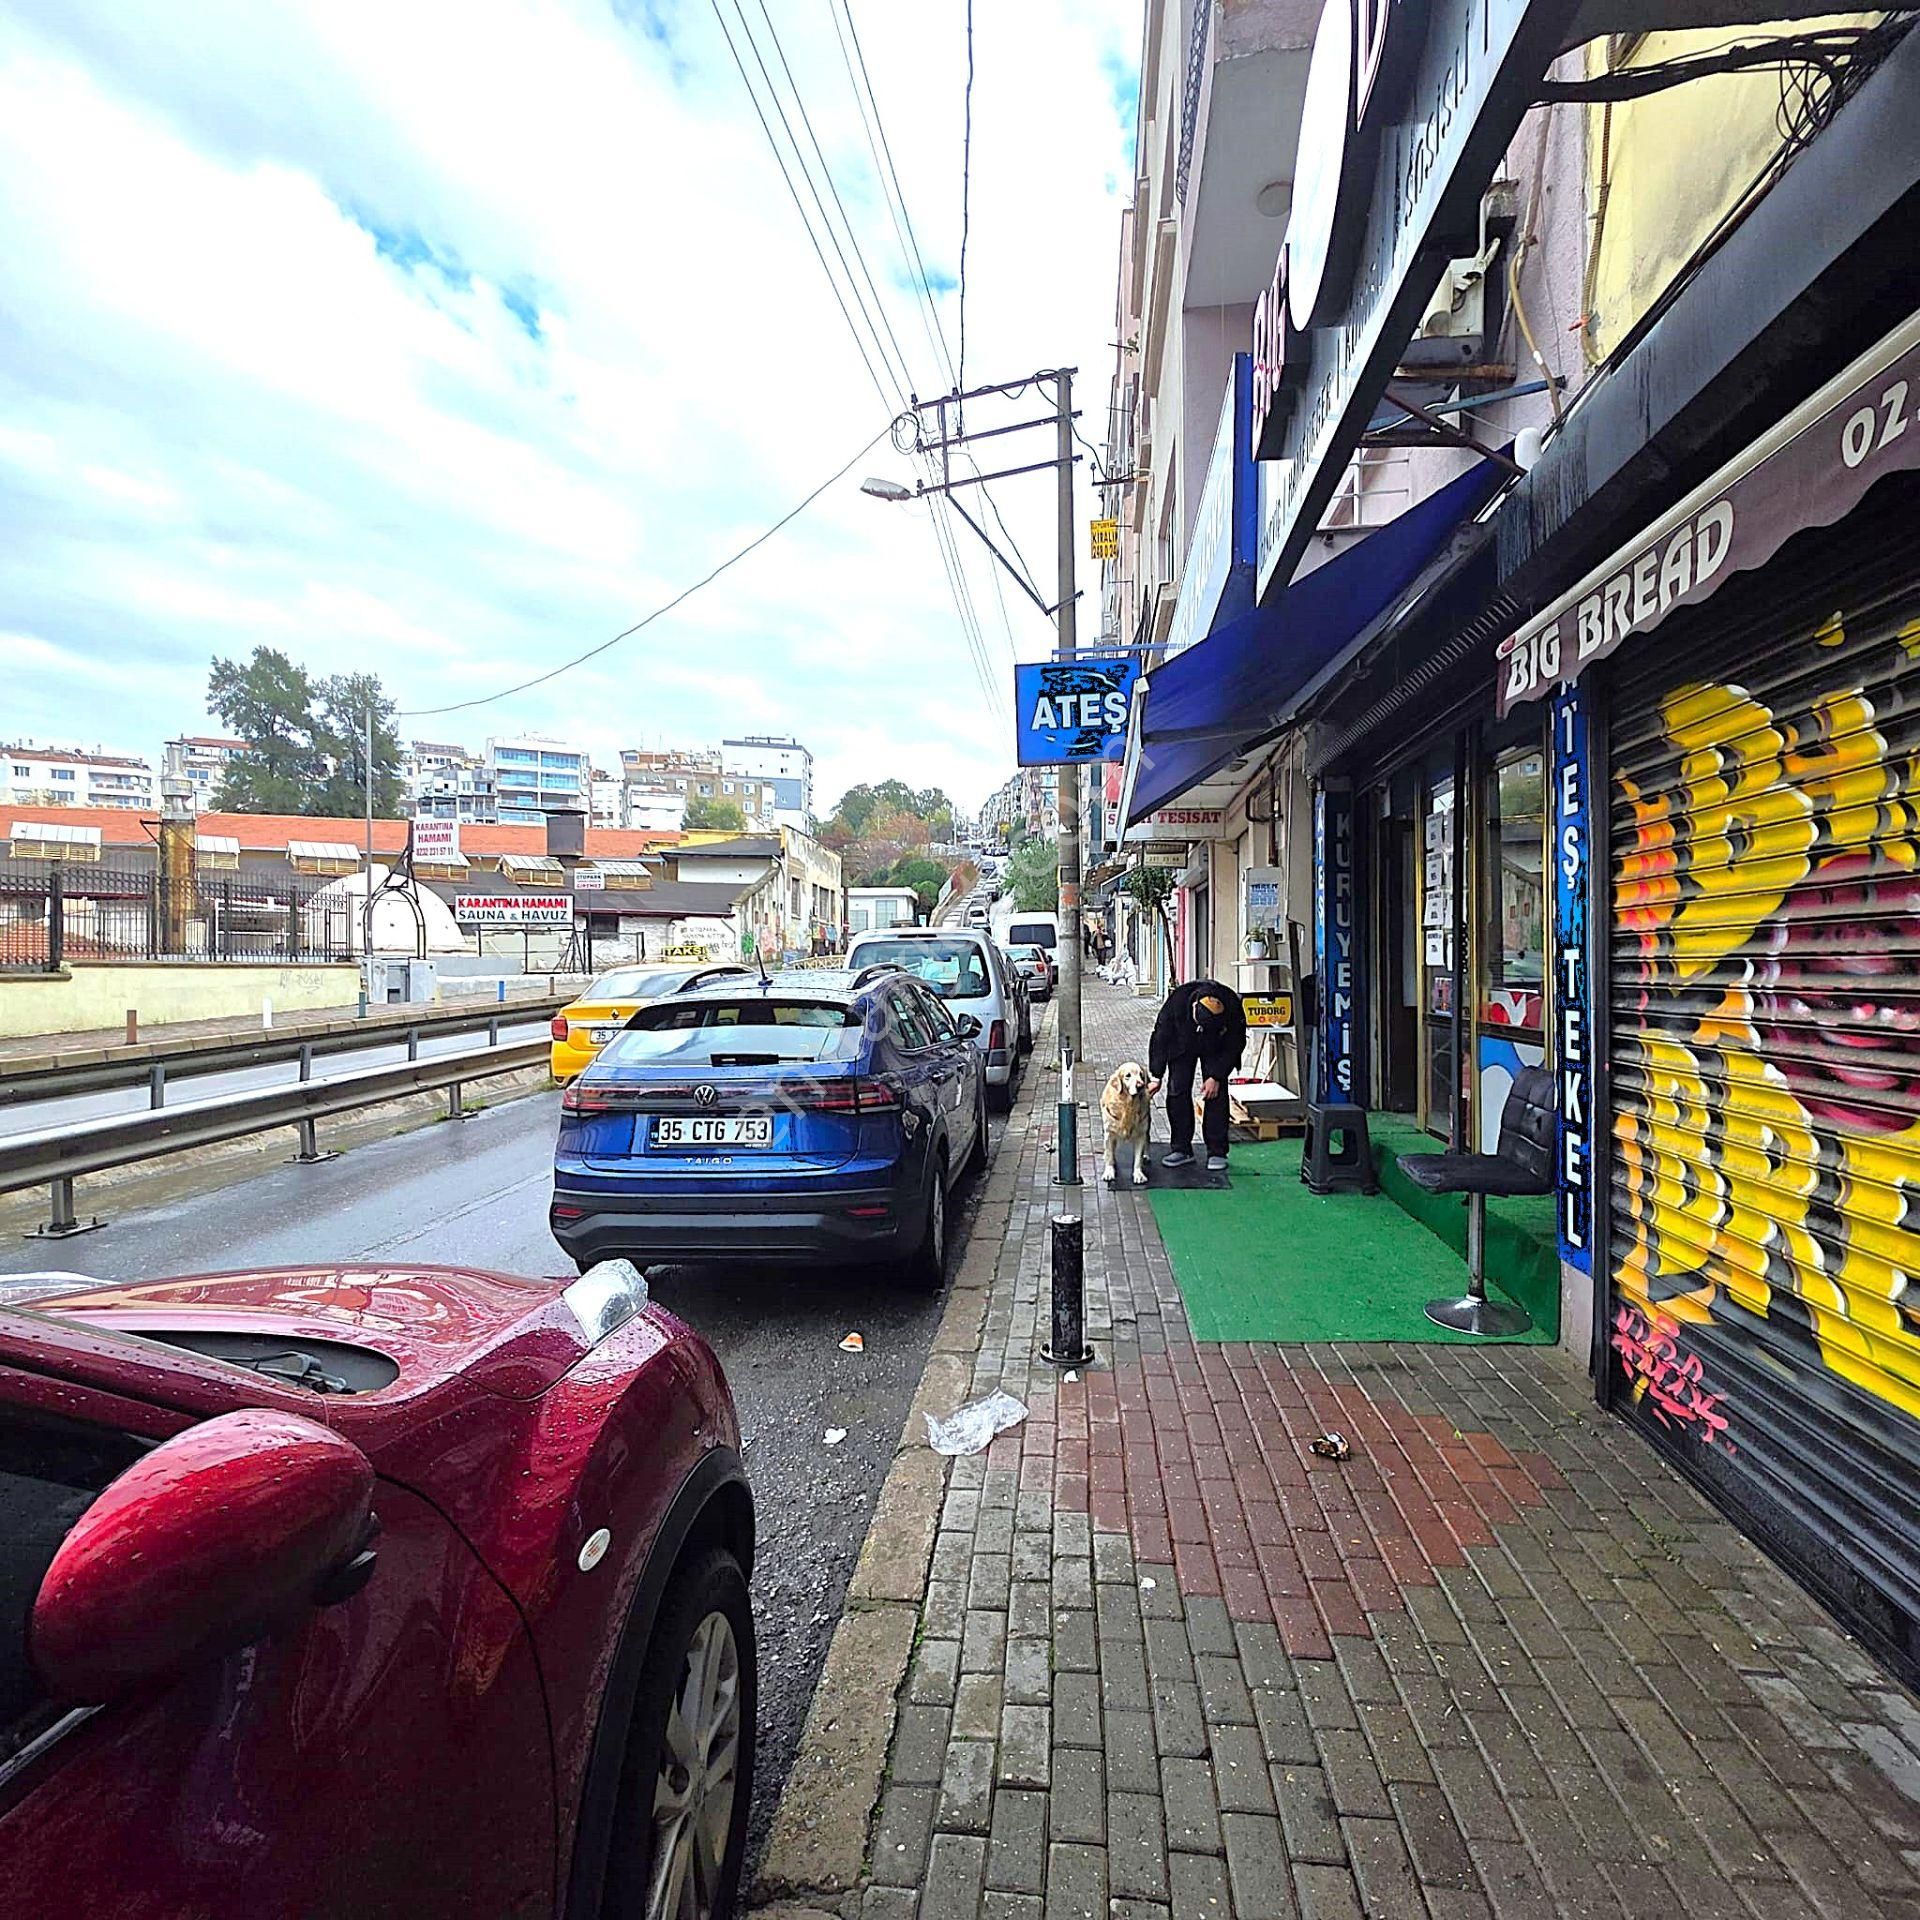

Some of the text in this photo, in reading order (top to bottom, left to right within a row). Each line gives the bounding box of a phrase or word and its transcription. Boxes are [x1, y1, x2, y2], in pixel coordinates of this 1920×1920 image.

[1505, 624, 1561, 700] BIG
[1578, 500, 1734, 660] BREAD
[1031, 692, 1127, 733] ATEŞ
[522, 898, 567, 908] HAMAMI
[459, 910, 505, 919] SAUNA
[522, 910, 567, 920] HAVUZ
[1334, 812, 1351, 1092] KURUYEMİŞ
[1248, 1006, 1286, 1016] TUBORG
[596, 1031, 606, 1040] 35
[1563, 949, 1582, 1249] TEKEL
[661, 1121, 767, 1140] 35 CTG 753
[685, 1157, 733, 1165] TAIGO
